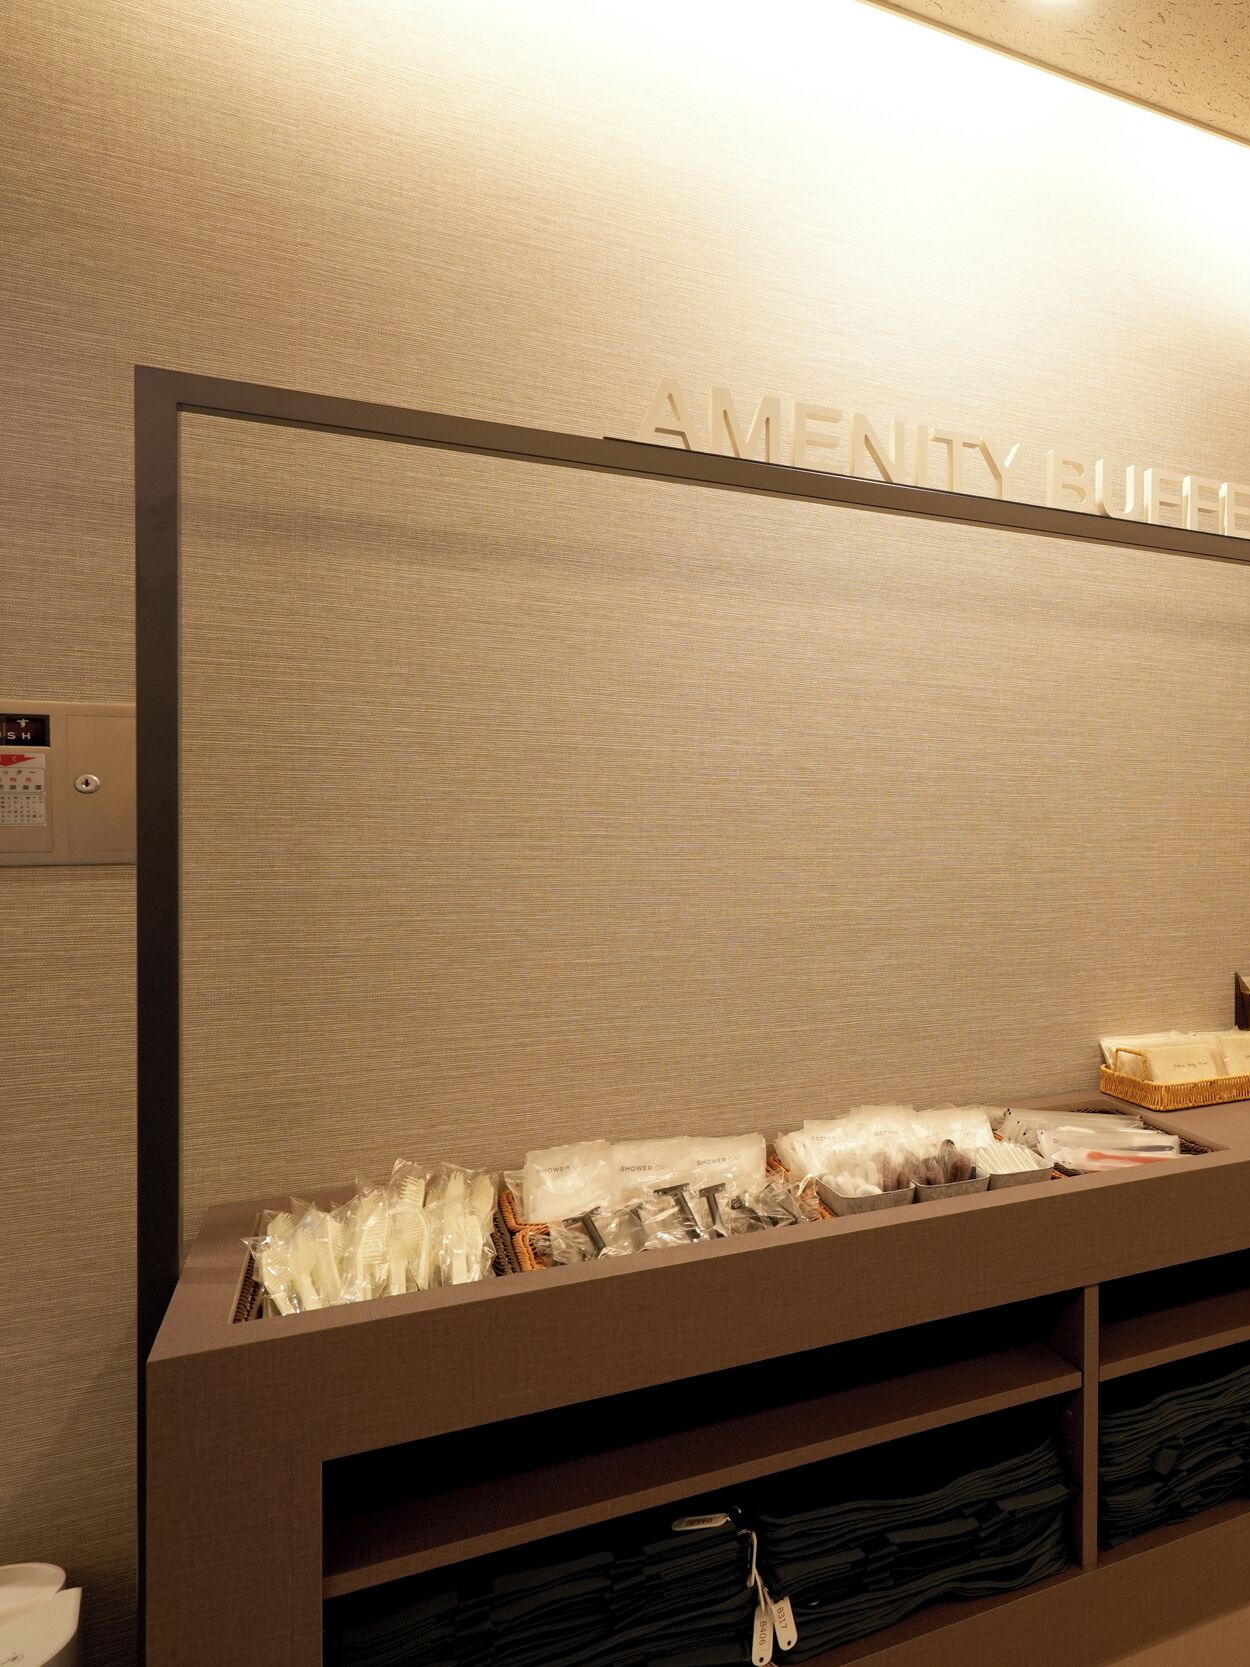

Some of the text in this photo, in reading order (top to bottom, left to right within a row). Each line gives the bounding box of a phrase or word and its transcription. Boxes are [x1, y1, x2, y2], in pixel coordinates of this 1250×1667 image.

[635, 376, 1020, 501] AMENITY
[0, 731, 31, 740] SH
[620, 1164, 653, 1172] SHOWER
[696, 1156, 727, 1167] SHOWER
[776, 1606, 788, 1629] B317
[758, 1620, 768, 1646] B406
